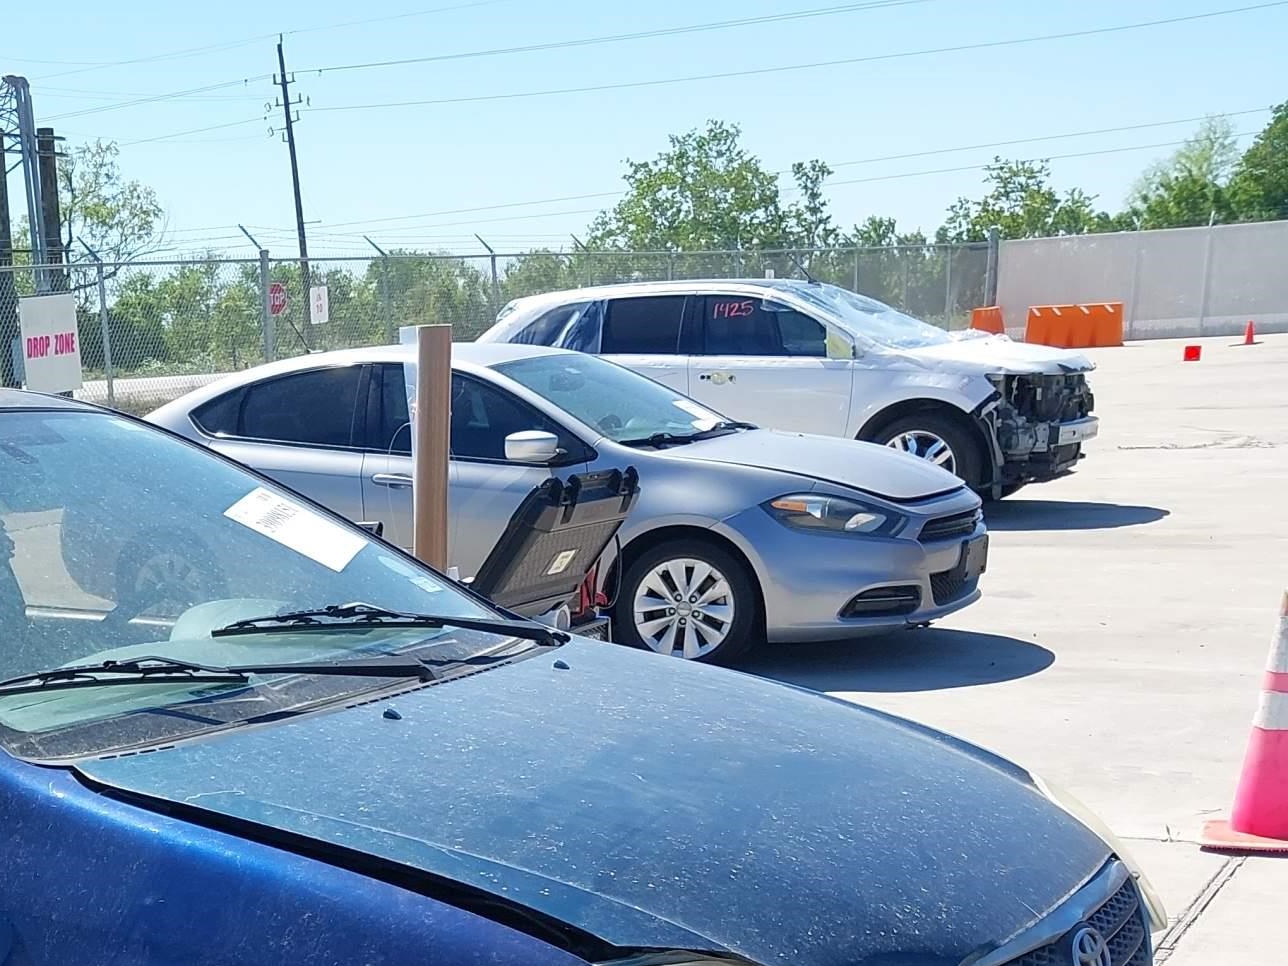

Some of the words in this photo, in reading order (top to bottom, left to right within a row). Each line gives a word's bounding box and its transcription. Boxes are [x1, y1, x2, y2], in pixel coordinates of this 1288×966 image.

[713, 300, 754, 319] 1425
[26, 335, 50, 359] DROP
[54, 332, 75, 355] ZONE
